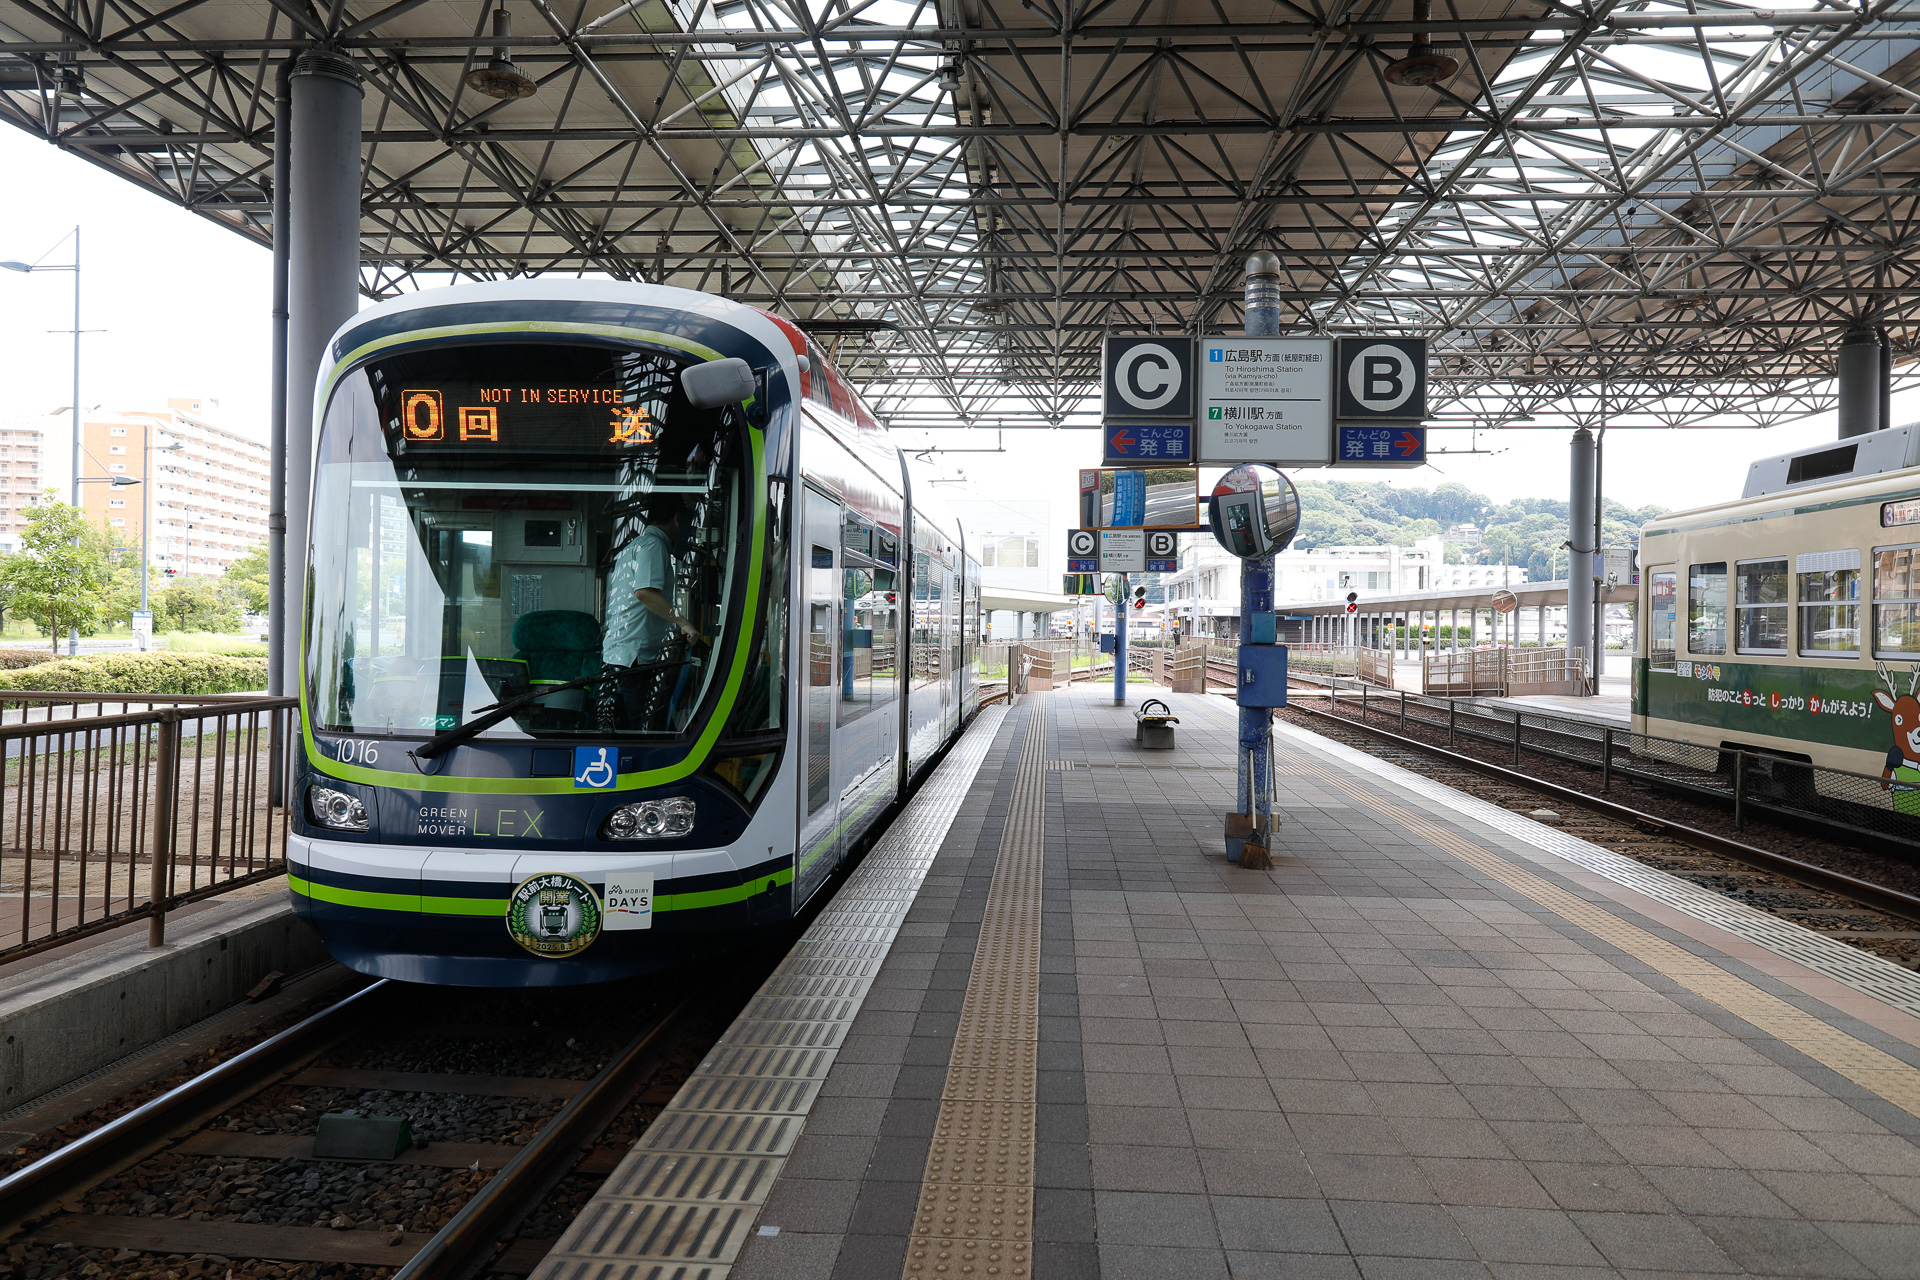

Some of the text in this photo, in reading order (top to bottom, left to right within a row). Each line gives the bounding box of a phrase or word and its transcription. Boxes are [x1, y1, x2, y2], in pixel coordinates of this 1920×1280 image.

[1214, 351, 1218, 360] 1
[1224, 349, 1263, 362] 広島駅
[1127, 353, 1170, 401] C
[1362, 355, 1404, 401] B
[480, 388, 623, 404] NOT IN SERVICE
[406, 393, 439, 437] 0
[1212, 407, 1283, 420] 7 横川駅 方面
[1140, 428, 1184, 438] こんどの
[1235, 423, 1274, 431] Yokogawa
[1346, 430, 1390, 439] こんどの
[1140, 439, 1184, 456] 発車
[1346, 441, 1390, 458] 発車
[1886, 507, 1893, 524] 3
[1075, 535, 1090, 551] C
[1156, 536, 1170, 551] B
[1708, 688, 1873, 718] 防犯のこともっと しっかり かんがえよう!
[420, 716, 456, 728] ワンマン
[335, 739, 380, 764] 1016
[420, 807, 467, 818] GREEN
[418, 824, 466, 835] MOVER
[473, 809, 544, 838] LEX
[518, 875, 592, 902] 駅前大橋ルート
[540, 890, 570, 905] 開業
[609, 897, 648, 907] DAYS
